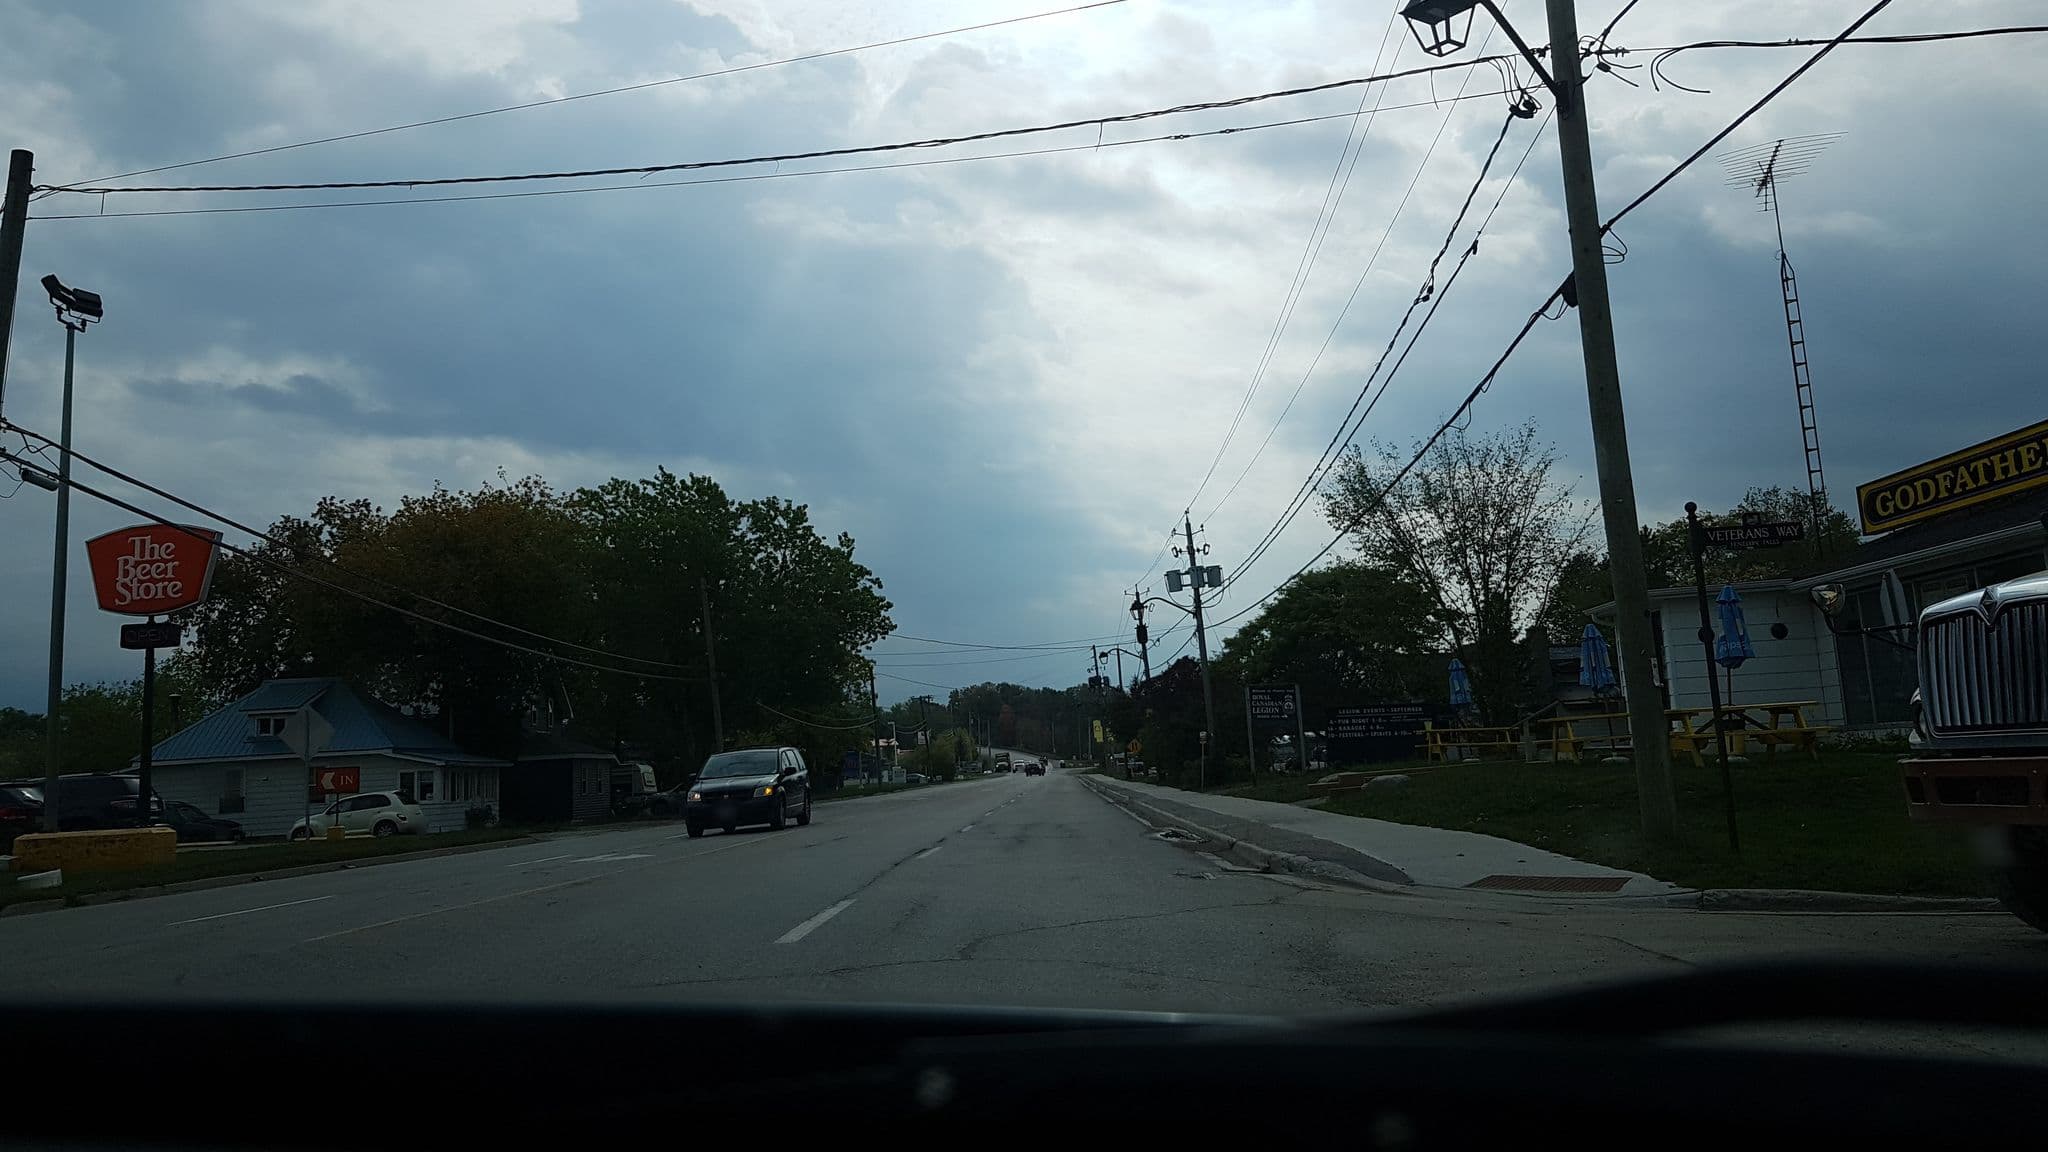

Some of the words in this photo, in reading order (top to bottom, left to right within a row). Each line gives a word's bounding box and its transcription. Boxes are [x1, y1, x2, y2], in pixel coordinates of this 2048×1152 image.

[1875, 438, 2048, 517] GODFATHE
[1707, 527, 1770, 541] VETERANS
[1776, 525, 1799, 537] WAY
[128, 535, 176, 560] The
[115, 556, 181, 582] Beer
[114, 578, 183, 605] Store
[340, 775, 354, 785] IN
